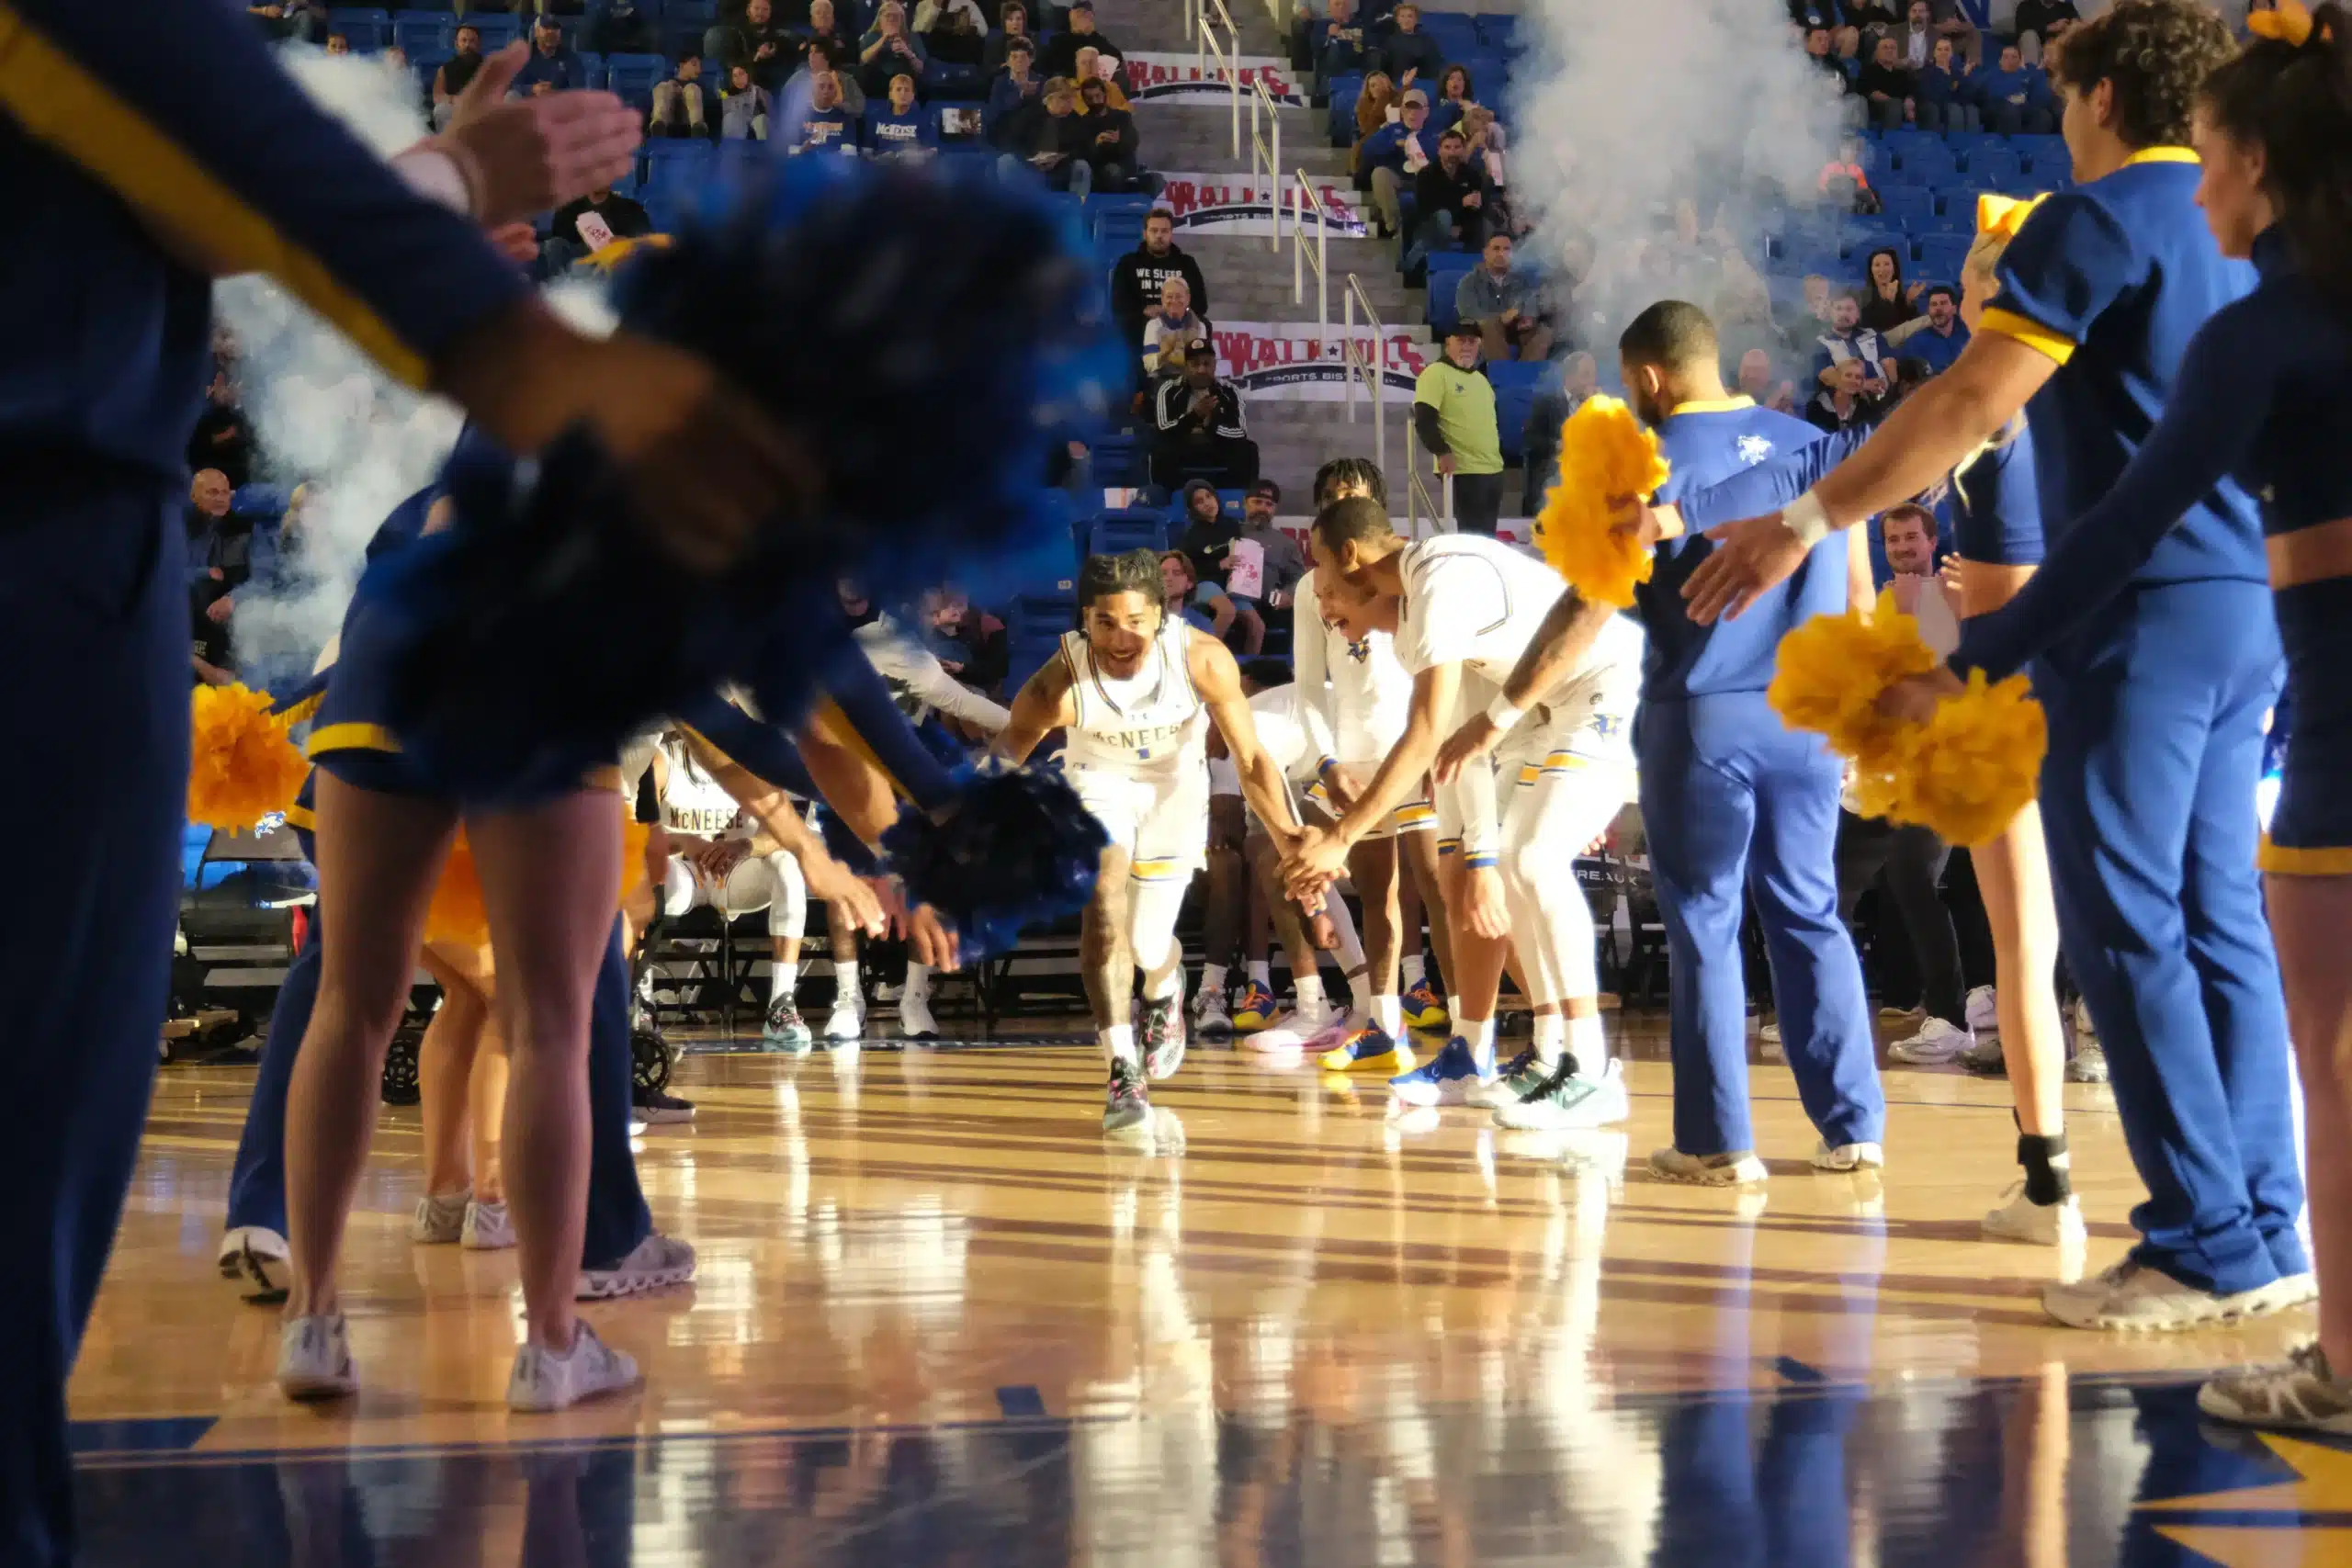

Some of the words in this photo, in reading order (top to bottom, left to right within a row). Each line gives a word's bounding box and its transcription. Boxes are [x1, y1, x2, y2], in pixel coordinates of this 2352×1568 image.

[1136, 268, 1150, 277] WE
[1153, 268, 1182, 279] SLEEP
[1141, 279, 1152, 289] IN
